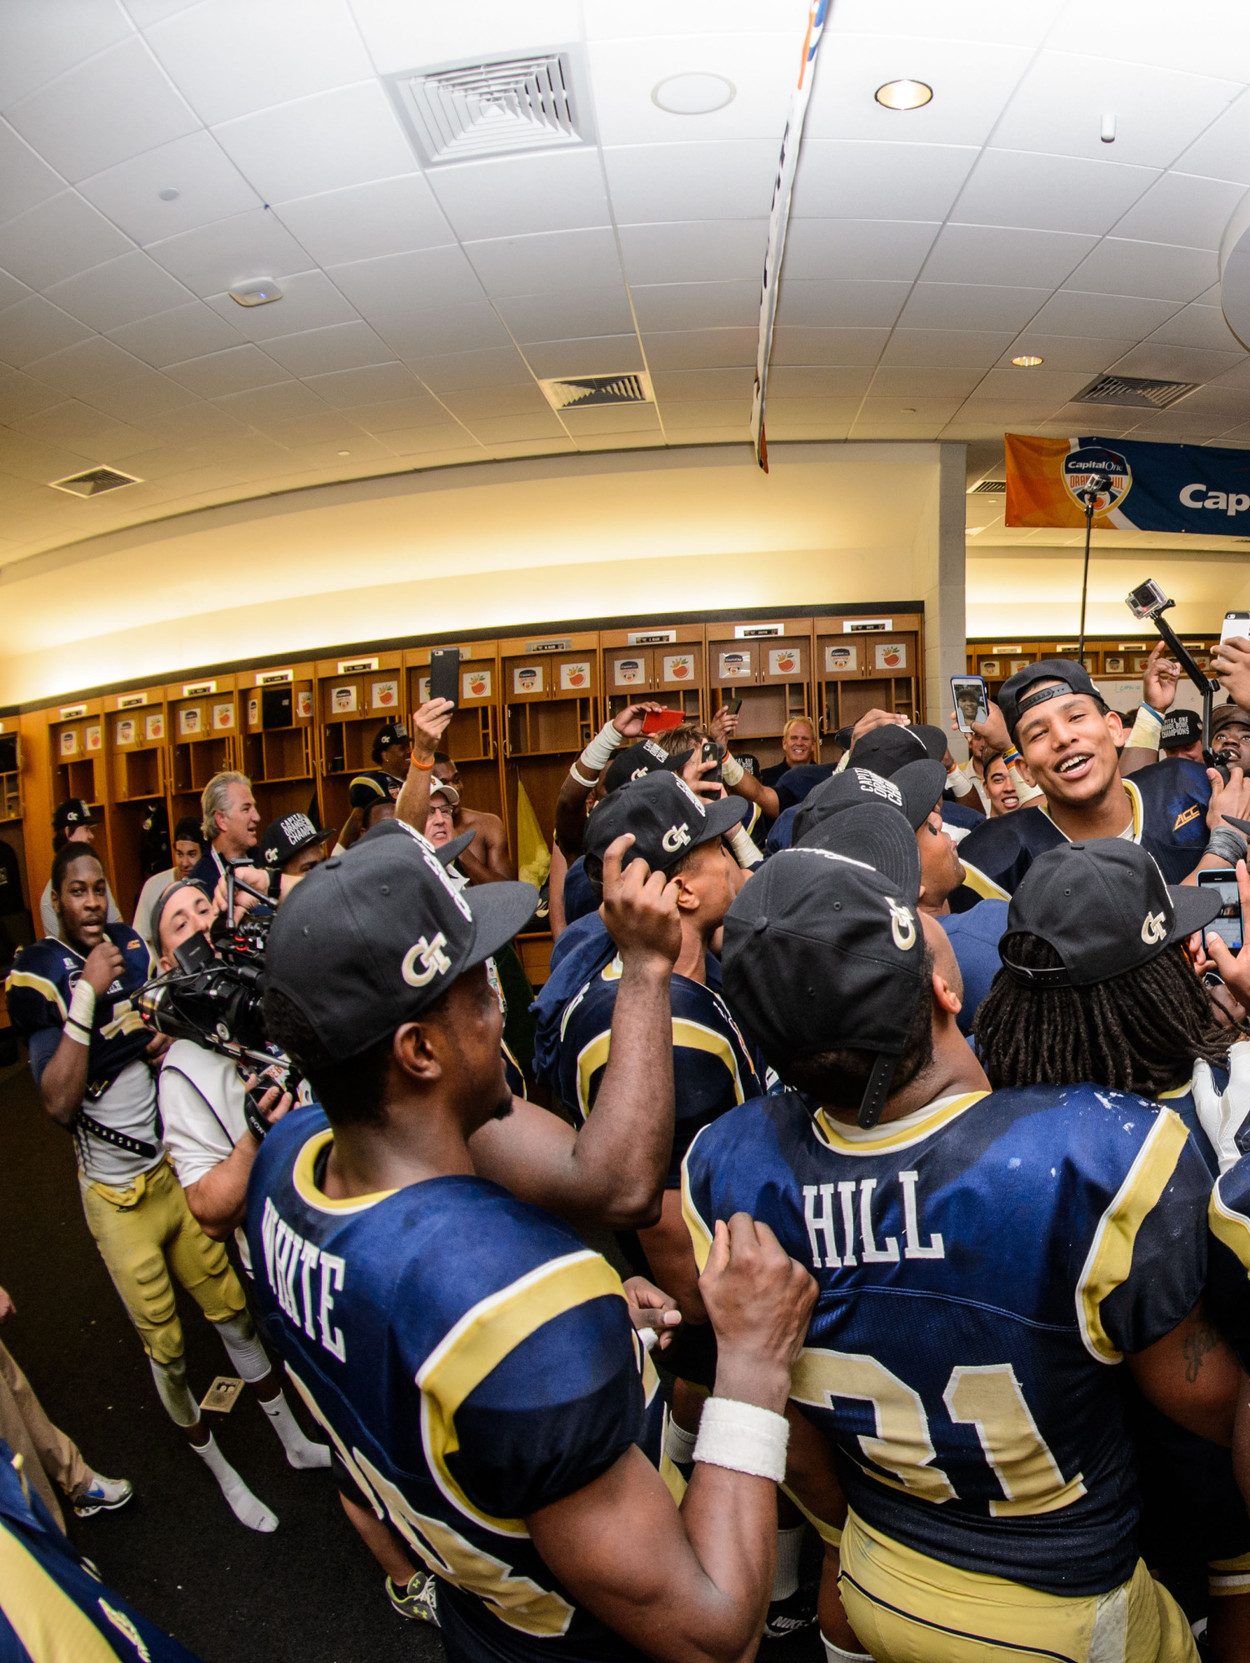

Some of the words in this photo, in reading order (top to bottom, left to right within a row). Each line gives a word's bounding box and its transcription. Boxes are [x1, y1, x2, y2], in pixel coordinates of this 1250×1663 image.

[260, 1196, 346, 1363] WHITE
[802, 1170, 945, 1268] HILL
[787, 1346, 1089, 1517] 31
